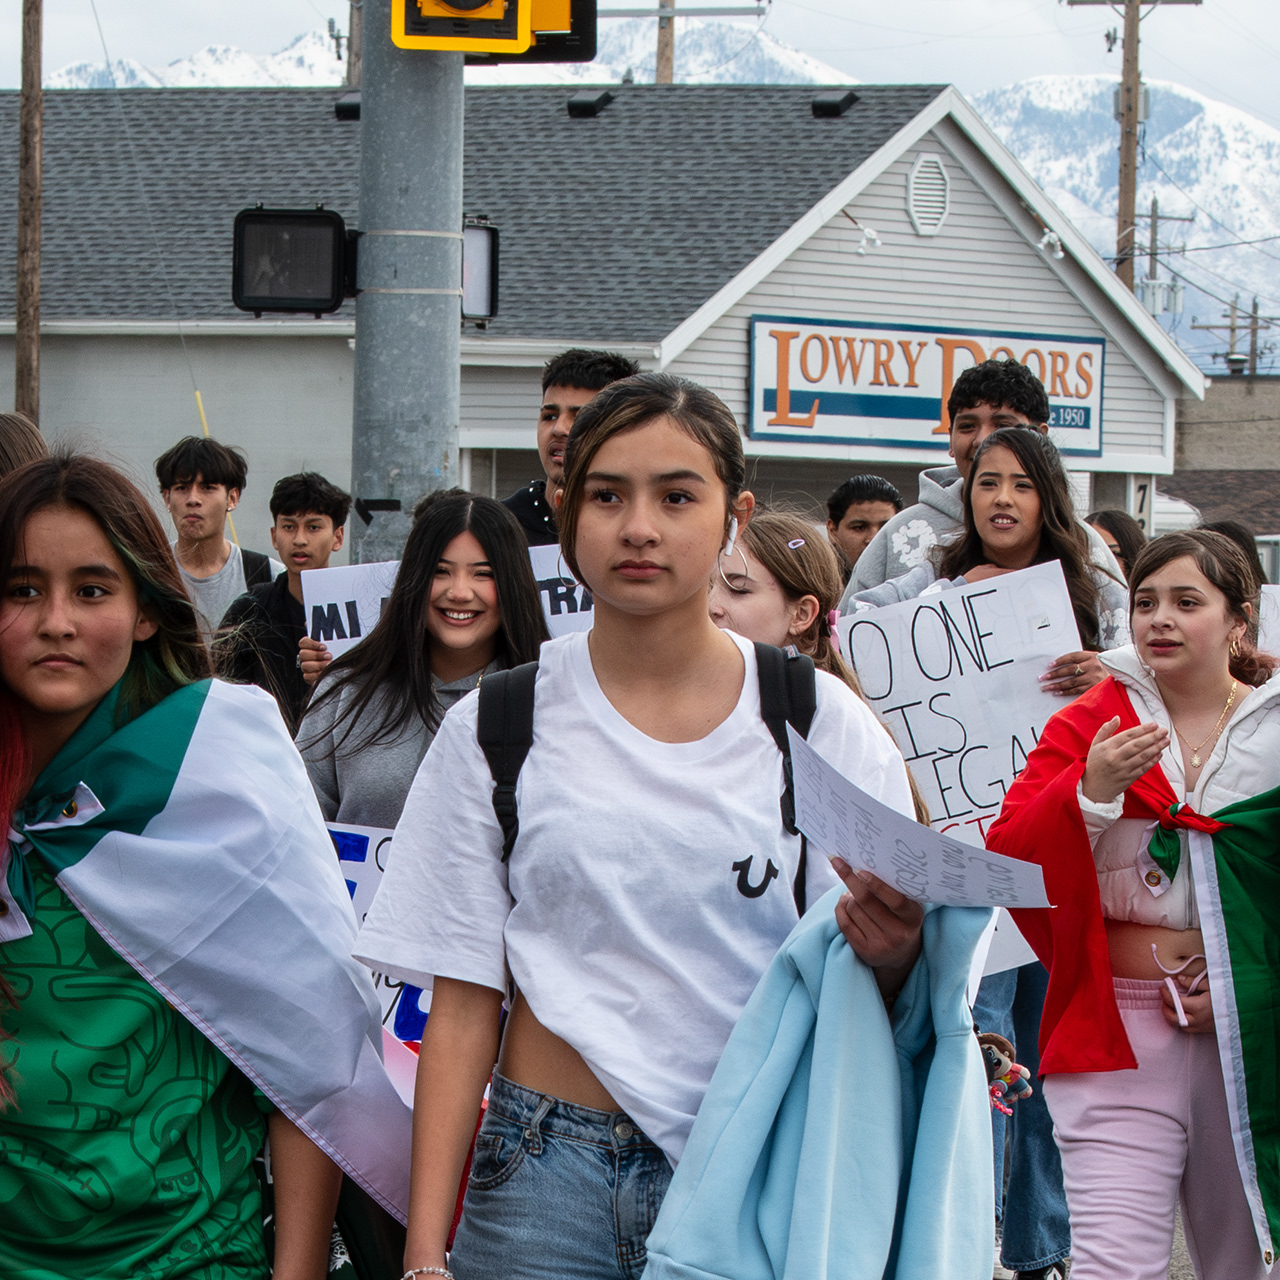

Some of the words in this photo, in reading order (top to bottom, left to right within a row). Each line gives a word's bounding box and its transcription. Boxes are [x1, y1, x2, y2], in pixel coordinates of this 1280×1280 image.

[767, 329, 927, 428] LOWRY
[1058, 408, 1086, 427] 1950
[310, 600, 362, 641] MI
[911, 589, 1015, 682] ONE
[881, 692, 967, 762] IS
